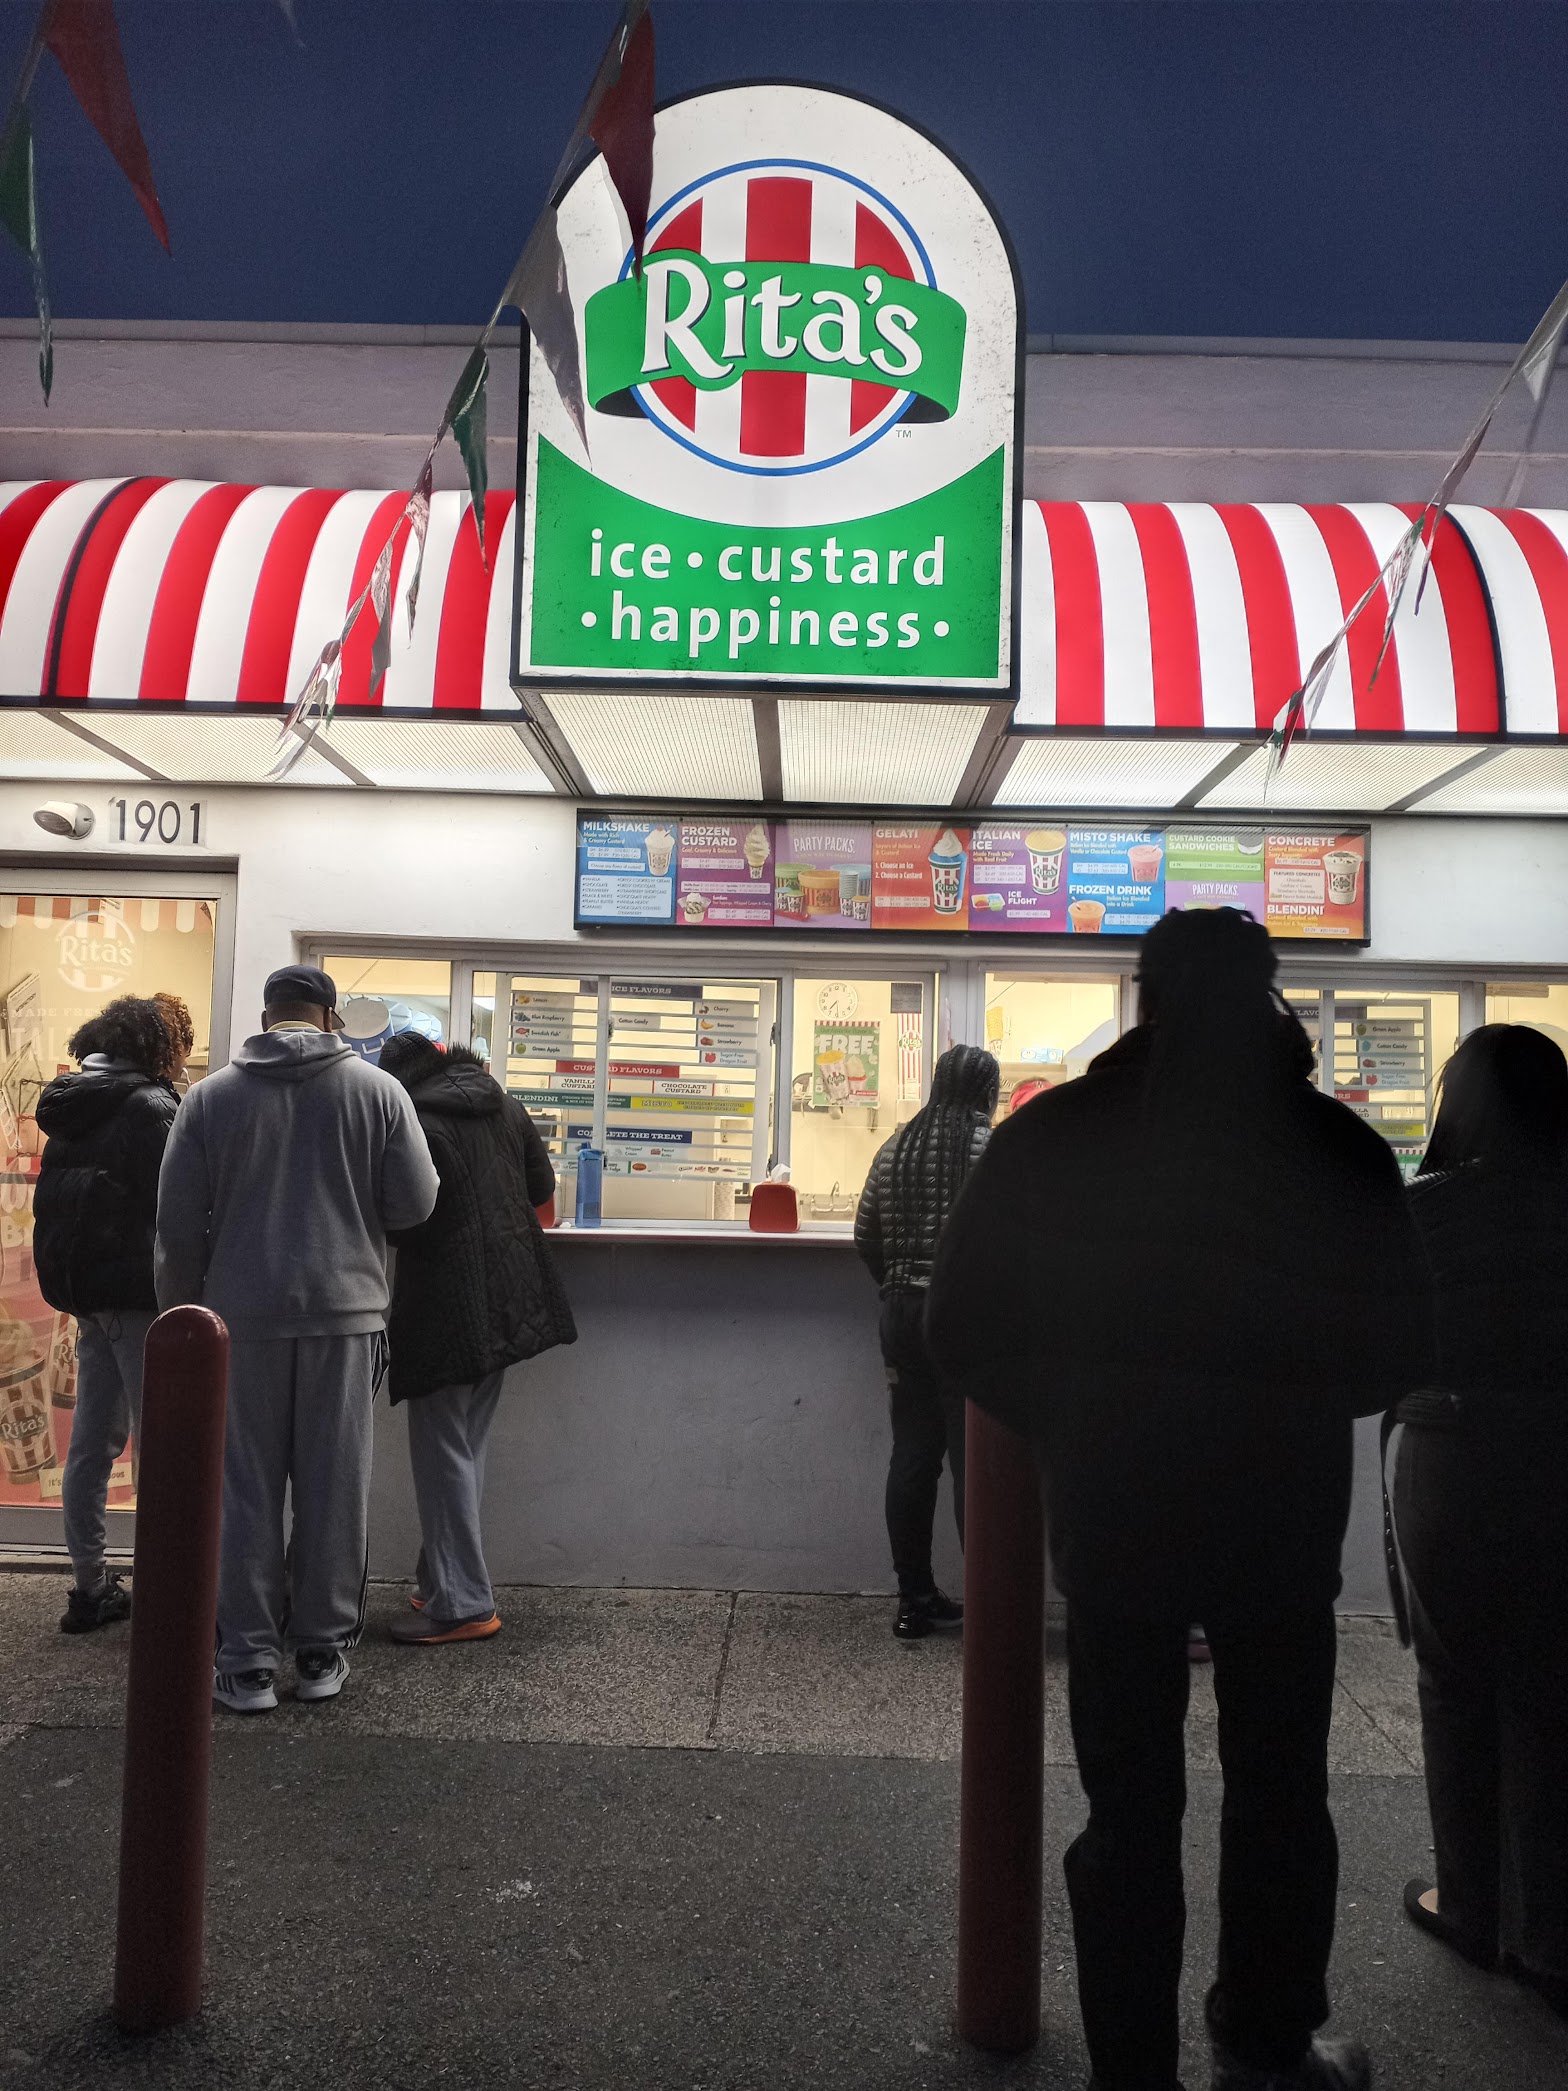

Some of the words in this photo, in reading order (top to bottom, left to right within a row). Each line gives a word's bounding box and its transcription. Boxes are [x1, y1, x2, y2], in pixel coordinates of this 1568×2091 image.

[641, 257, 923, 379] Rita's
[896, 430, 912, 438] TM
[591, 529, 670, 579] ice
[718, 536, 944, 586] custard
[611, 591, 920, 659] happiness
[116, 800, 201, 843] 1901
[583, 821, 650, 832] MILKSHAKE
[682, 826, 730, 836] FROZEN
[876, 829, 918, 838] GELATI
[973, 831, 1020, 840] ITALIAN
[681, 836, 737, 846] CUSTARD
[1070, 832, 1107, 842] MISTO
[1110, 833, 1151, 842] SHAKE
[1268, 836, 1335, 846] CONCRETE
[794, 837, 822, 852] PARTY
[972, 841, 992, 850] ICE
[1168, 843, 1234, 851] SANDWICHES
[1069, 885, 1114, 894] FROZEN
[1117, 885, 1152, 895] DRINK
[1192, 884, 1214, 895] PARTY
[1267, 905, 1324, 915] BLENDINI
[60, 936, 133, 967] Rita's
[629, 986, 672, 994] FLAVORS
[11, 1008, 56, 1016] MADE
[820, 1034, 874, 1055] FREE
[651, 1132, 683, 1140] TREAT
[1, 1414, 45, 1439] Rita's
